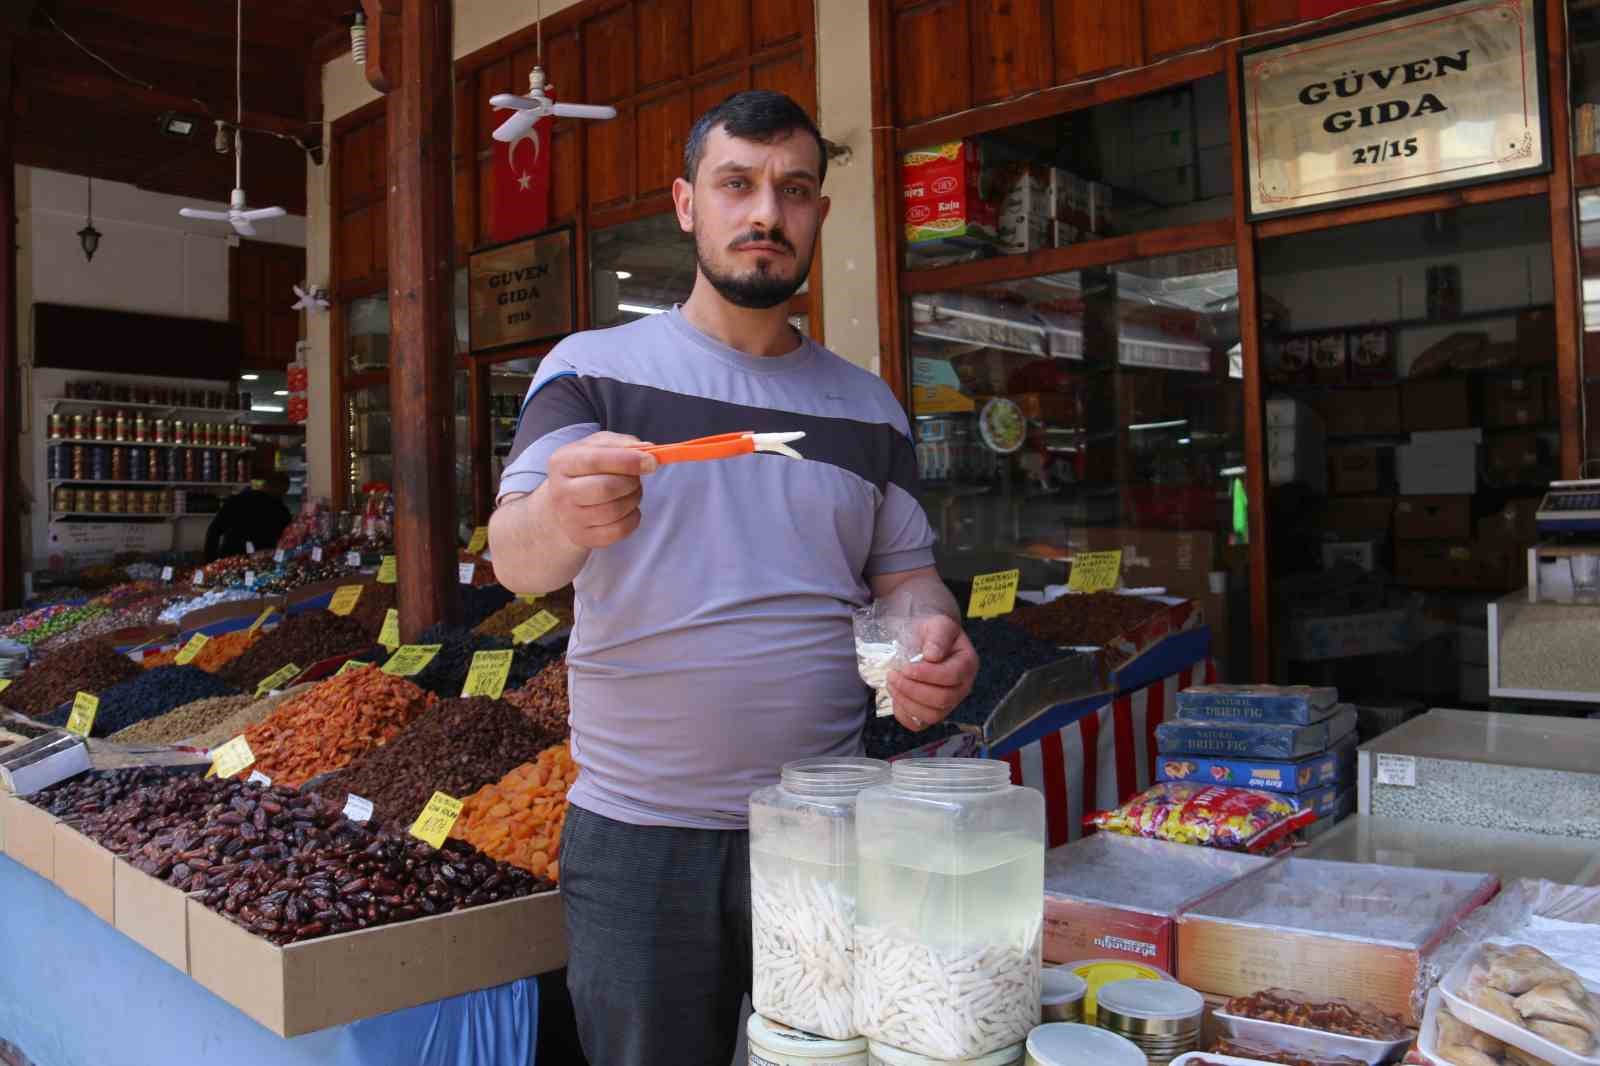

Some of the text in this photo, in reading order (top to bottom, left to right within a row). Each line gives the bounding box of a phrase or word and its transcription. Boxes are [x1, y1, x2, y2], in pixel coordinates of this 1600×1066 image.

[1298, 49, 1471, 105] GÜVEN
[1323, 93, 1448, 133] GIDA
[1352, 137, 1418, 165] 27/15
[496, 286, 541, 305] GIDA
[1243, 707, 1263, 718] FIG
[1227, 740, 1248, 751] FIG
